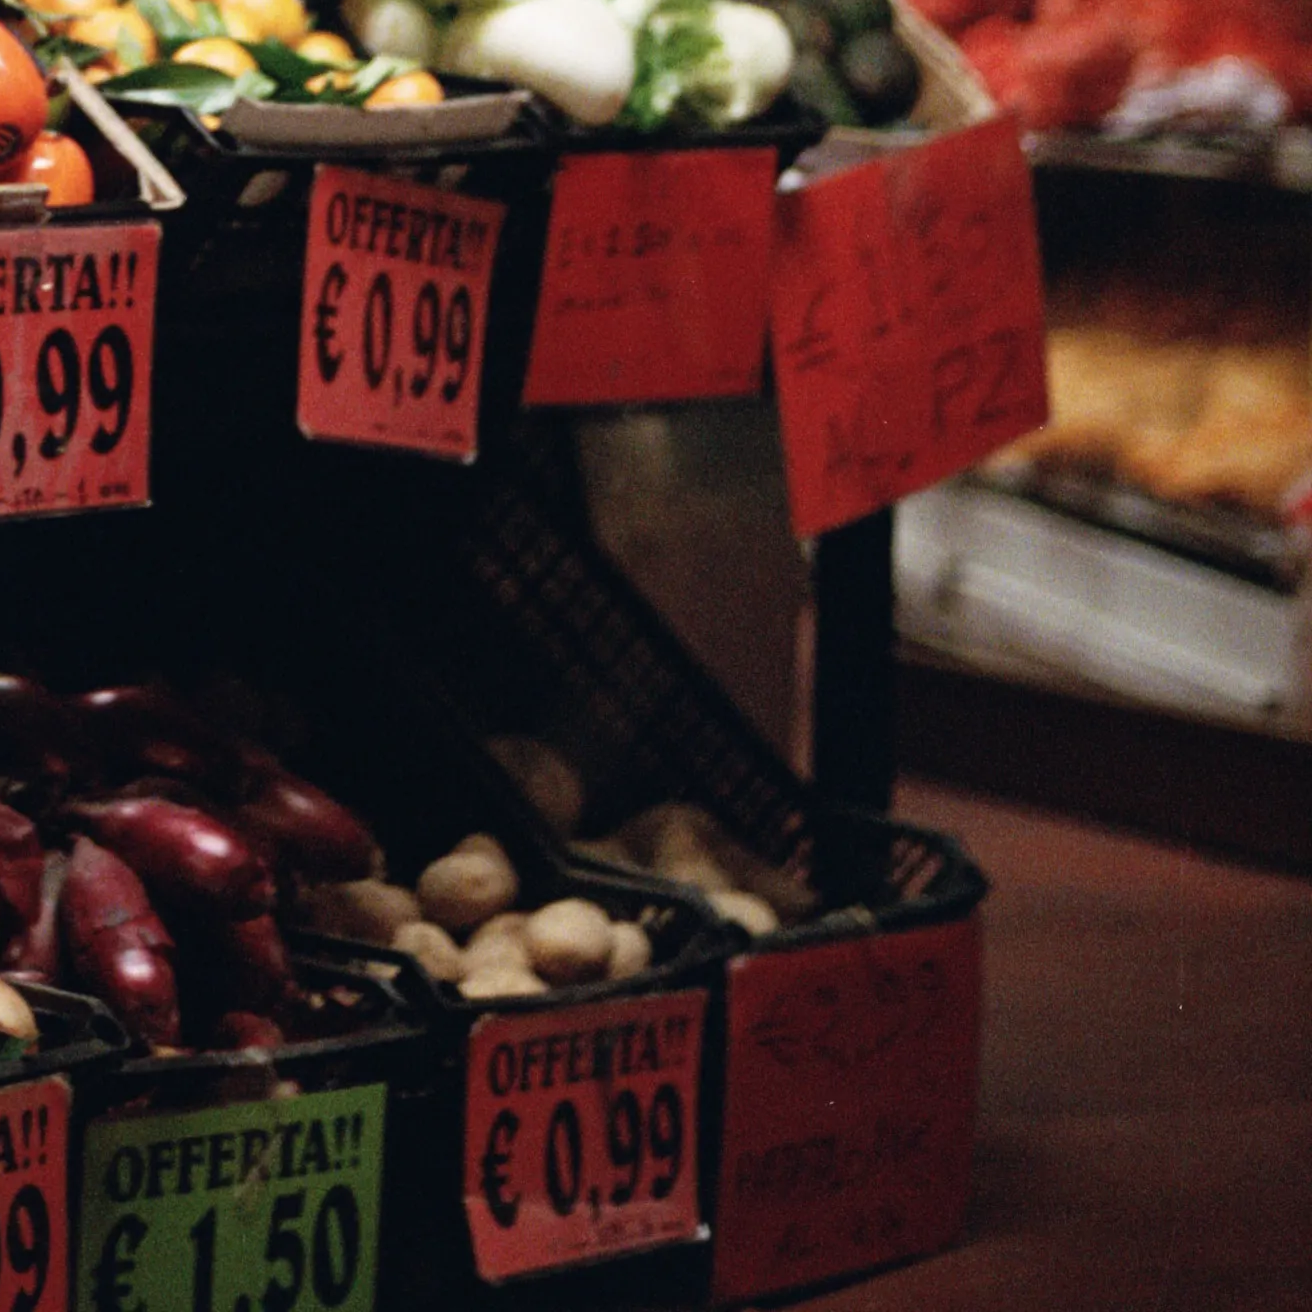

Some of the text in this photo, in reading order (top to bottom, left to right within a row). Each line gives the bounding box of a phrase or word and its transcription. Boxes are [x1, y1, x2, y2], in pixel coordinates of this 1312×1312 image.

[315, 262, 470, 406] € 0,99
[482, 1110, 520, 1228] €
[548, 1084, 682, 1223] 0,99
[92, 1213, 148, 1312] €
